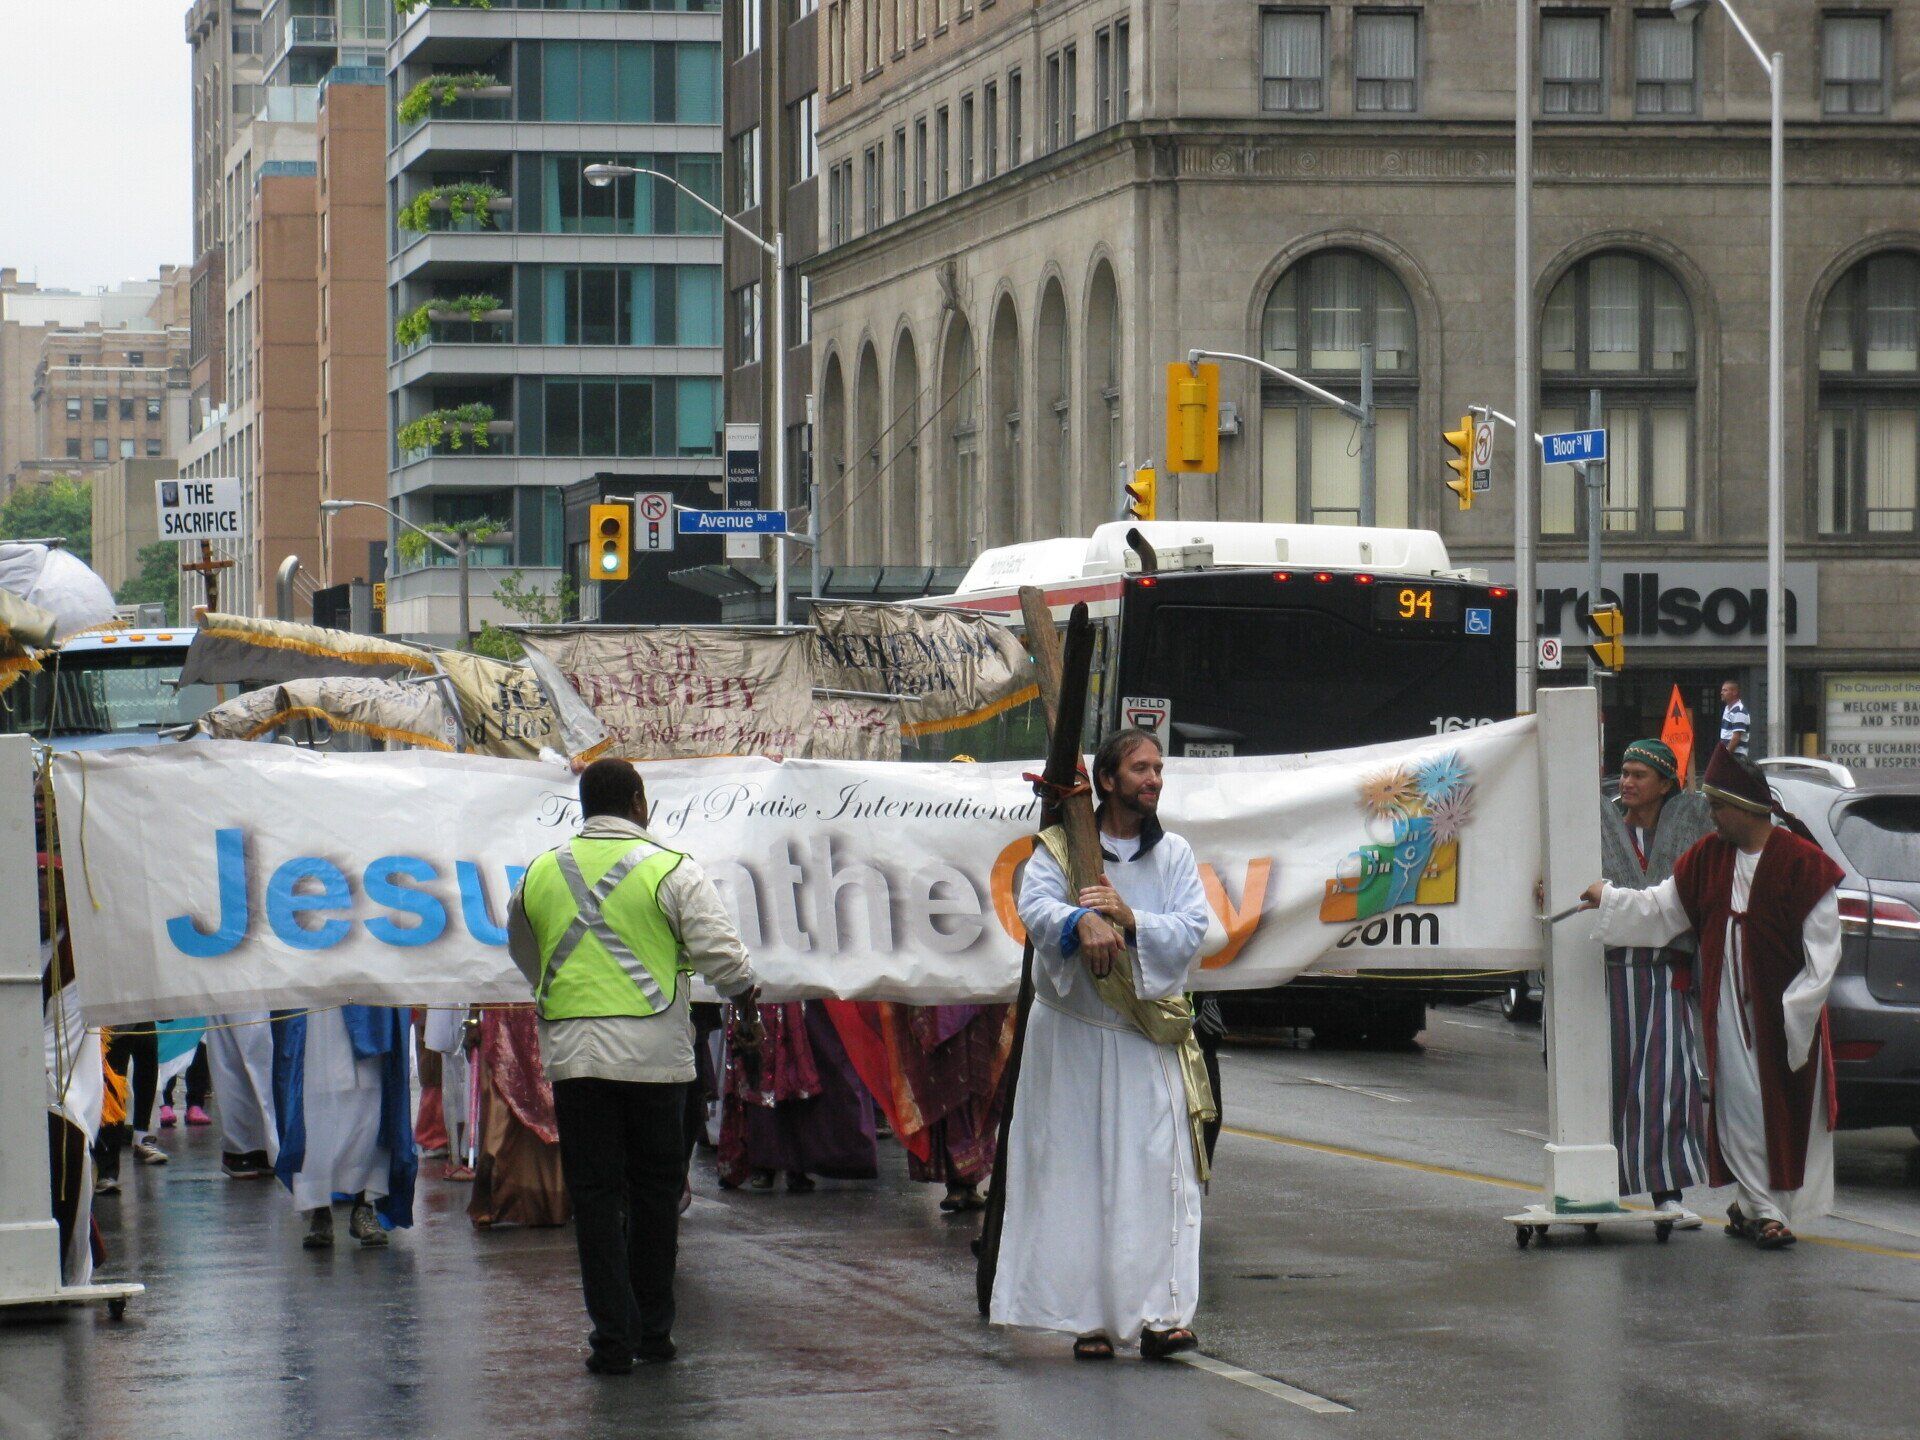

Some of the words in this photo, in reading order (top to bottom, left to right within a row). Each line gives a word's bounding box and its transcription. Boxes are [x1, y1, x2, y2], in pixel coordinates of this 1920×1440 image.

[1553, 438, 1575, 456] Bloor
[1577, 436, 1582, 445] St
[1583, 434, 1592, 453] W
[184, 484, 214, 505] THE
[165, 511, 237, 534] SACRIFICE
[699, 513, 753, 528] Avenue
[757, 514, 767, 522] Rd
[1399, 589, 1432, 618] 94
[1536, 573, 1797, 635] rellson
[1835, 683, 1852, 692] The
[1854, 683, 1890, 692] Church
[1892, 683, 1902, 692] of
[1127, 698, 1165, 708] YIELD
[1843, 702, 1897, 712] WELCOME
[1903, 702, 1920, 712] BA
[1861, 716, 1883, 727] AND
[1890, 715, 1920, 726] STUD
[1831, 743, 1860, 754] ROCK
[1838, 757, 1866, 768] BACH
[666, 795, 699, 839] of
[704, 783, 806, 822] Praise
[816, 780, 1037, 821] International
